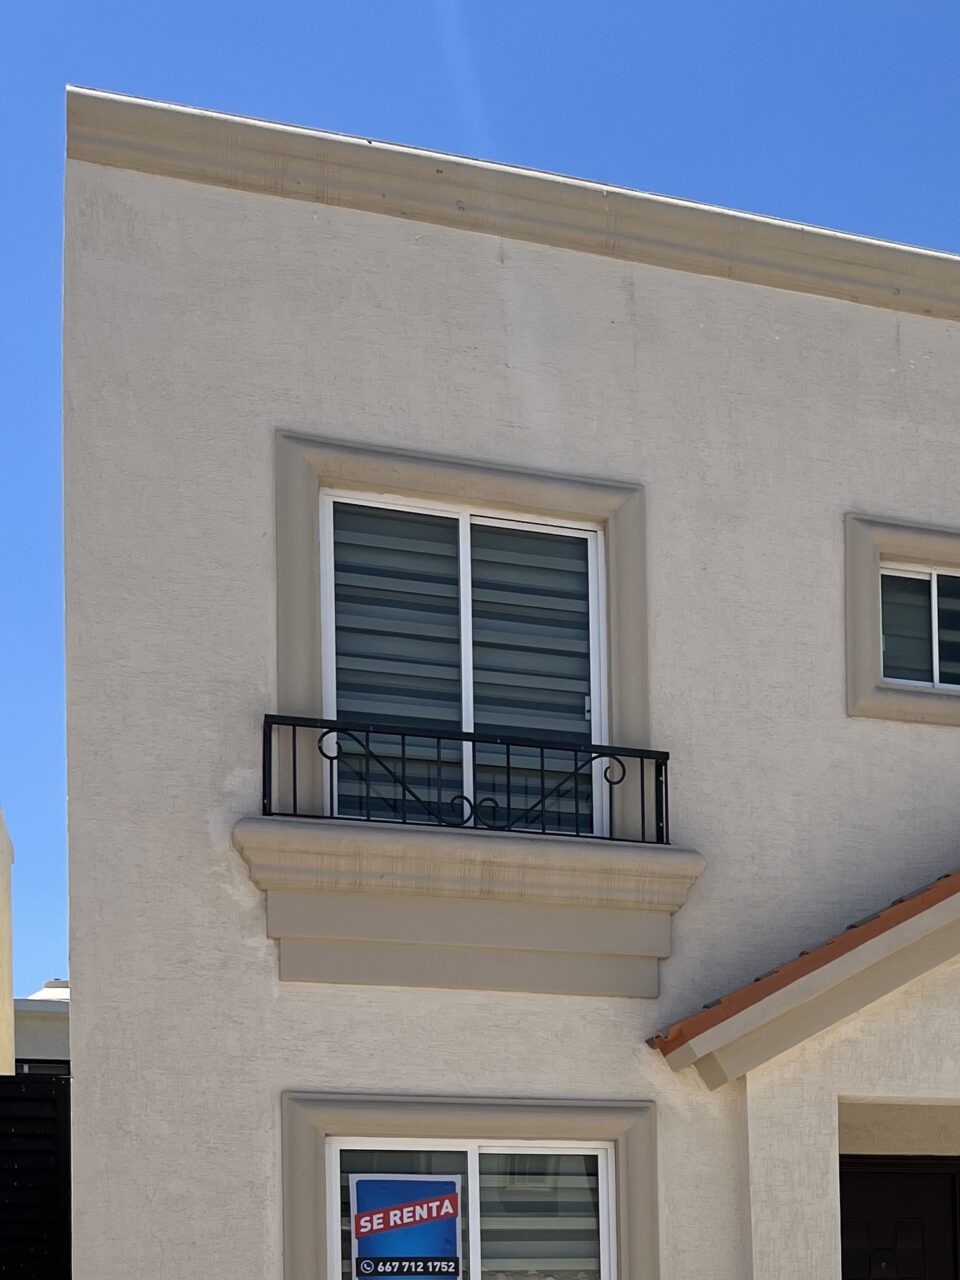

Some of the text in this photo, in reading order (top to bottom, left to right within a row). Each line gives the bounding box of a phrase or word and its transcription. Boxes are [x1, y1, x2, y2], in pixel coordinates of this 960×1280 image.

[360, 1199, 454, 1233] SE RENTA
[377, 1261, 455, 1272] 667 712 1752
